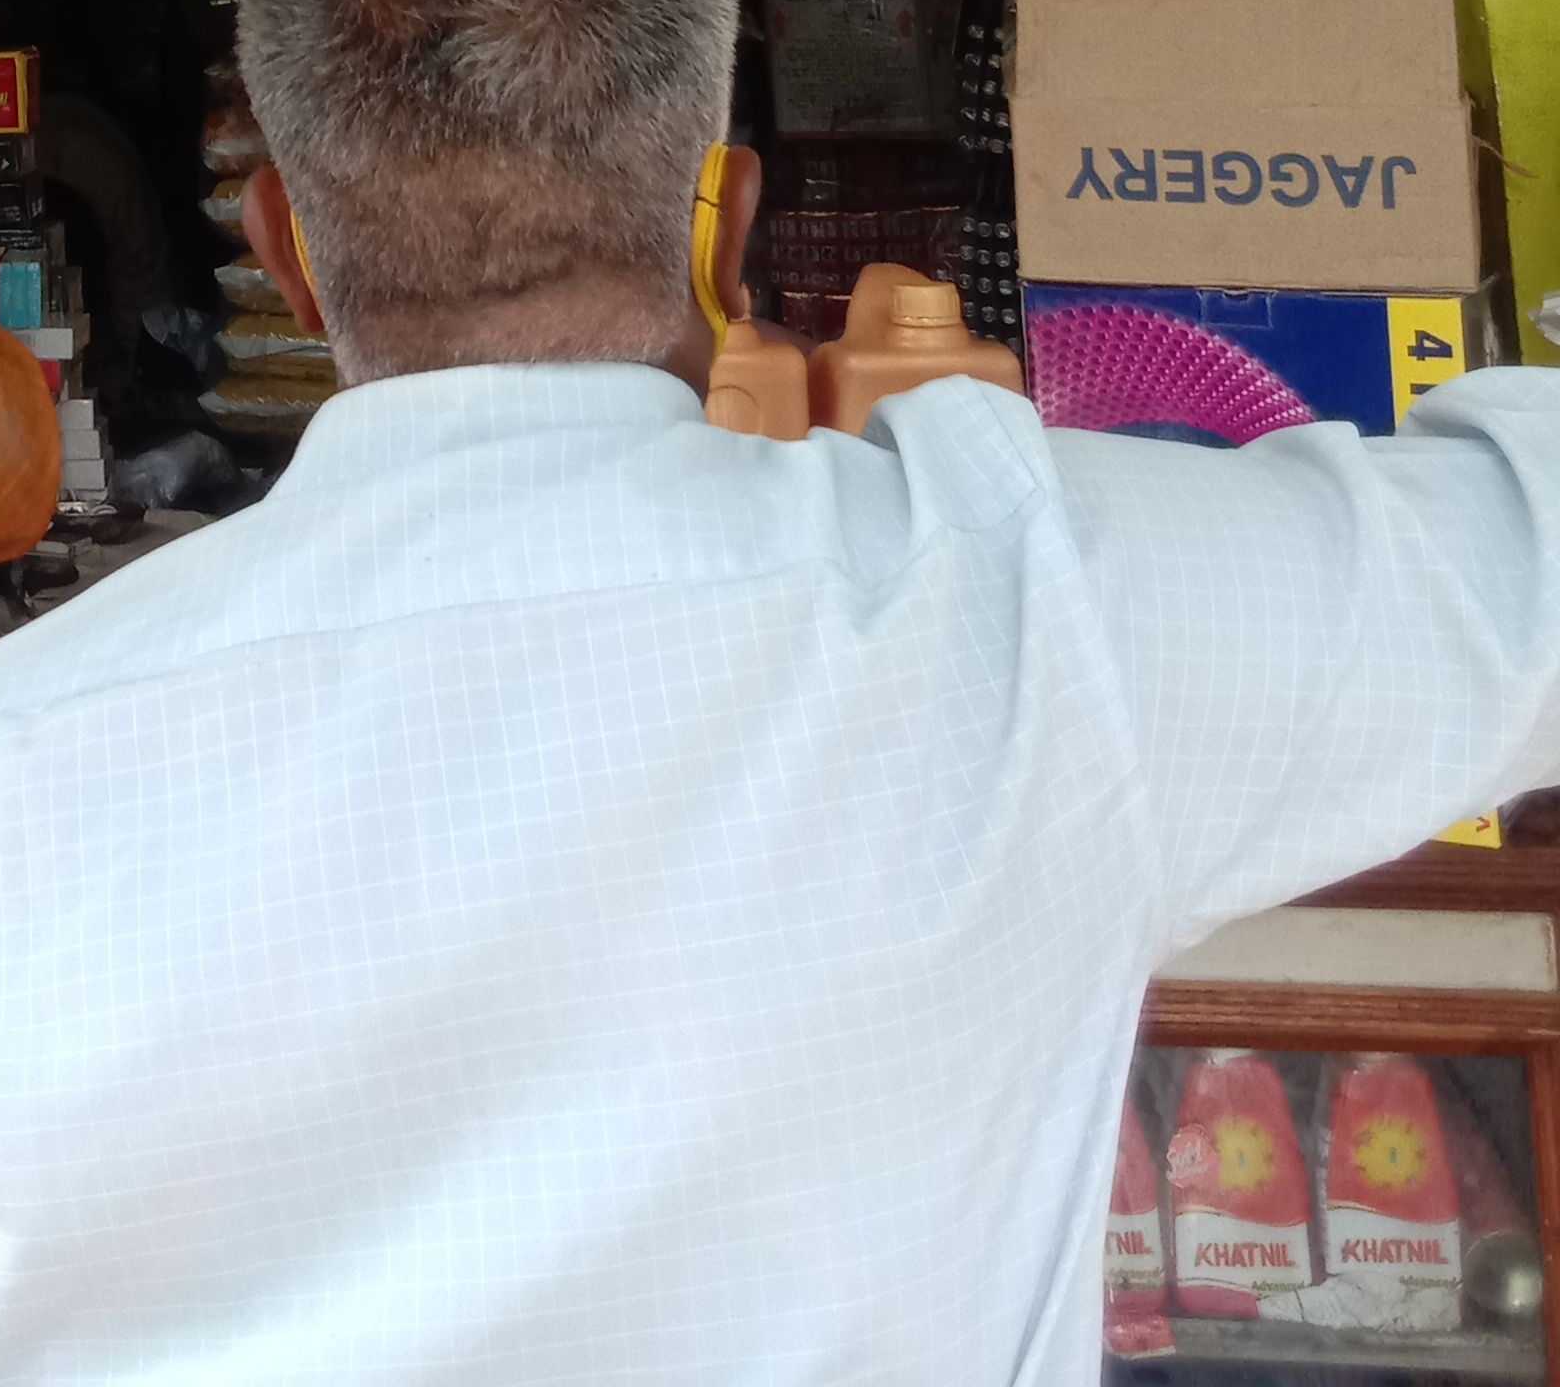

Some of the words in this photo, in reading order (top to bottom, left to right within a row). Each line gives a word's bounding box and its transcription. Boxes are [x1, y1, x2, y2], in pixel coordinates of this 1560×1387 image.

[1065, 146, 1418, 210] JAGGERY
[1406, 329, 1453, 362] 4
[1105, 1231, 1153, 1256] TNIL
[1195, 1242, 1296, 1268] KHATNIL
[1342, 1238, 1448, 1265] KHATNIL
